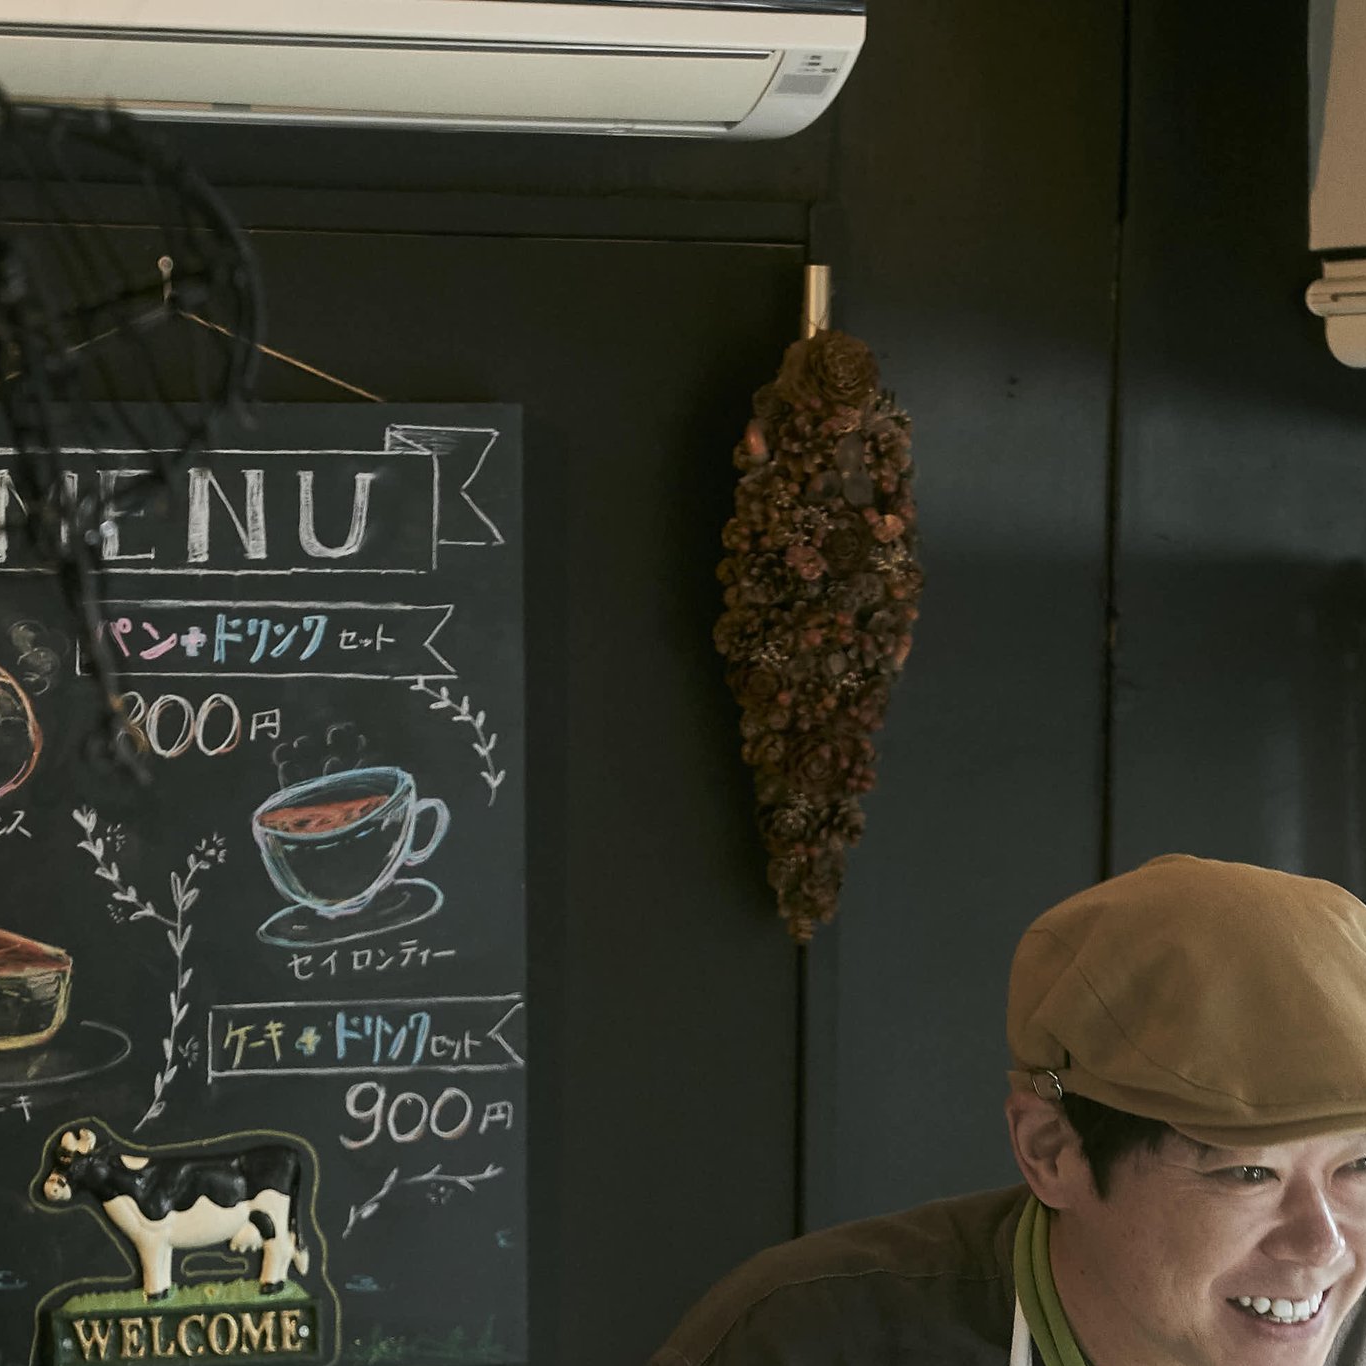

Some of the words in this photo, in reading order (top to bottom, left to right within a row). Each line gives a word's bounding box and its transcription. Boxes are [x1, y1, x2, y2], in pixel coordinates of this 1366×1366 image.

[287, 939, 457, 981] セイロンティー
[72, 1308, 302, 1362] WELCOME
